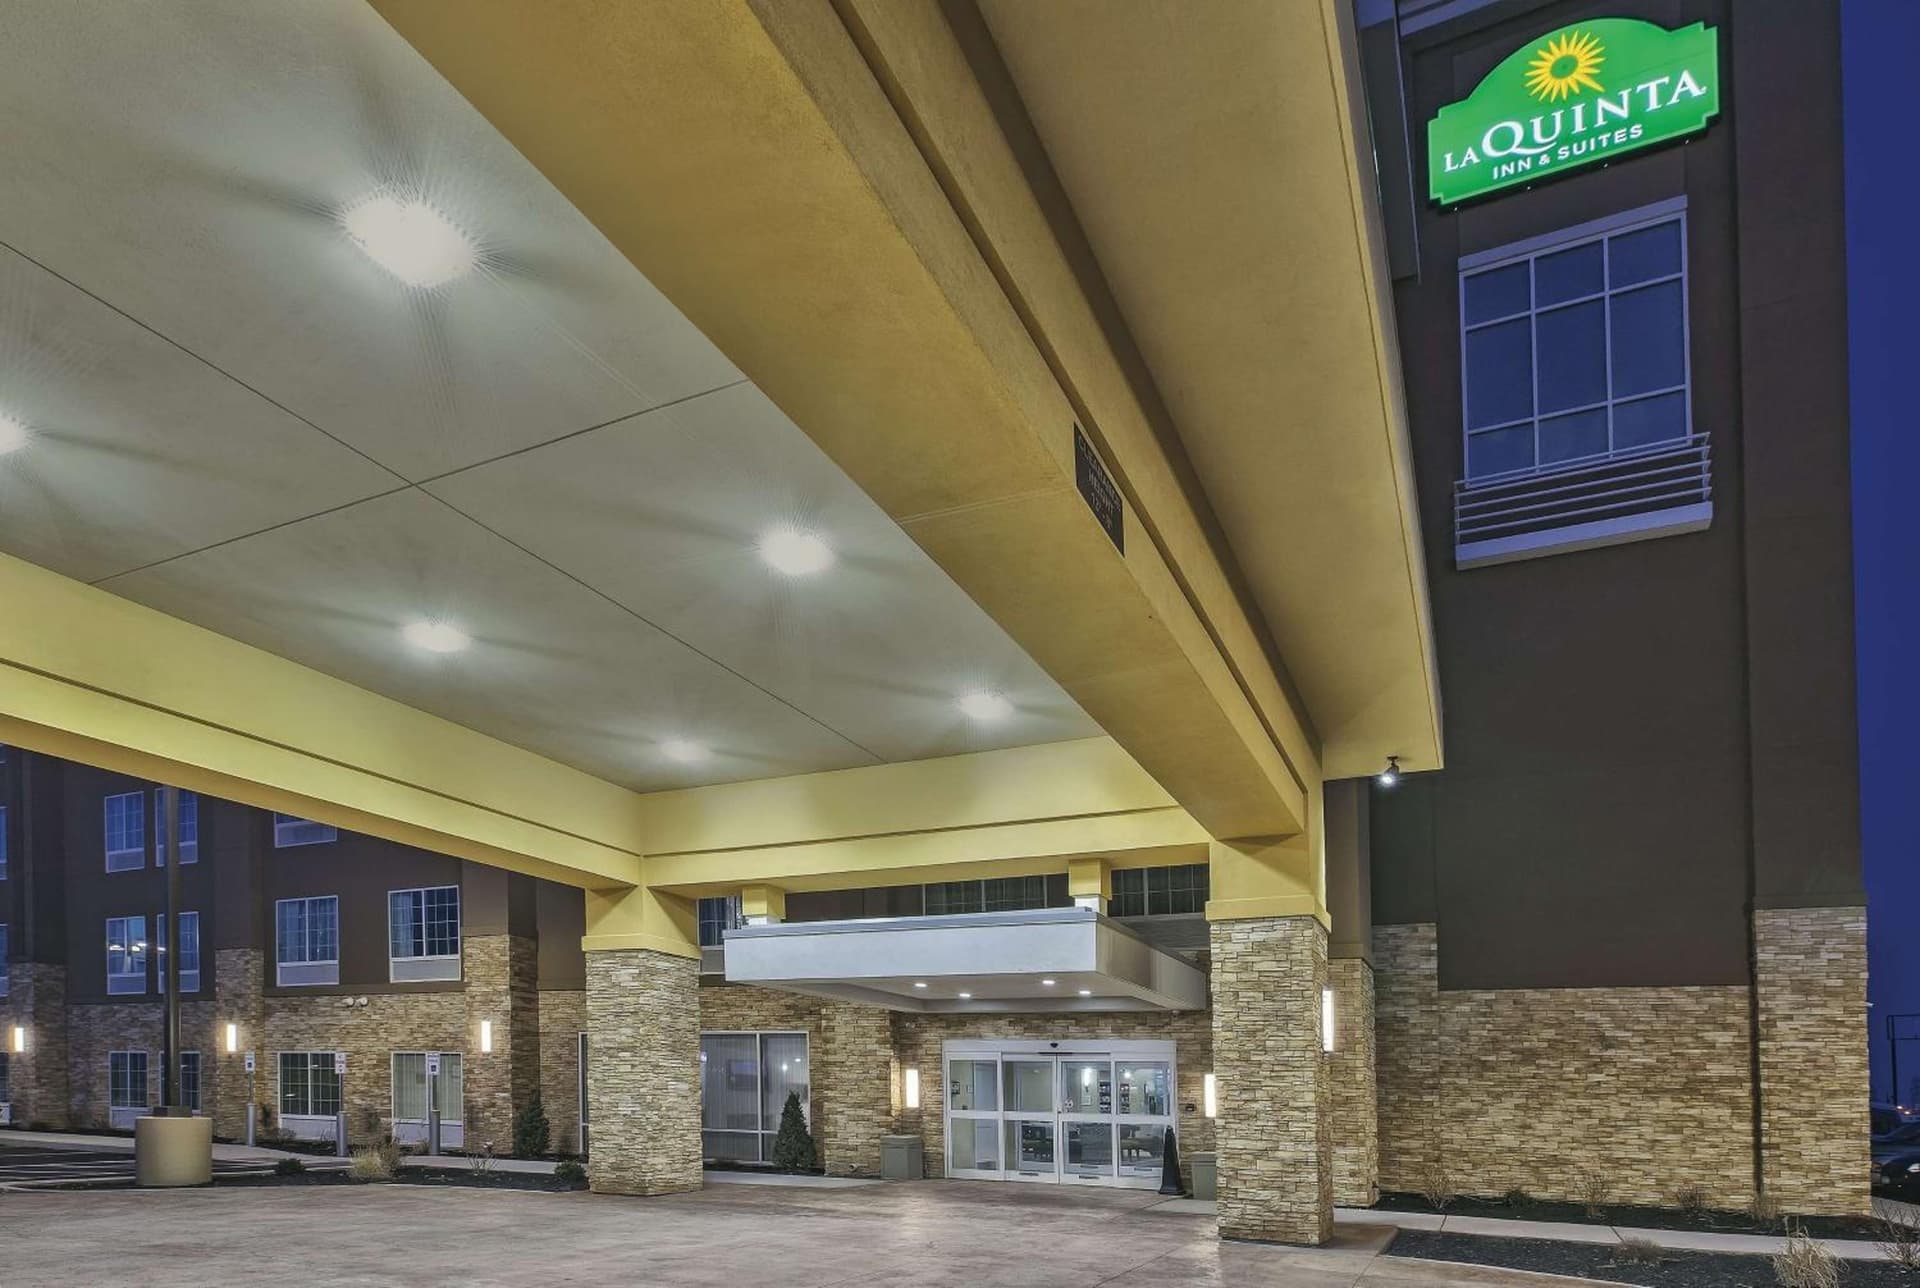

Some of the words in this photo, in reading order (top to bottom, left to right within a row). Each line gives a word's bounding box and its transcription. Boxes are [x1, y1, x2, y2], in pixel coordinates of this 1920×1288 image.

[1444, 147, 1480, 172] LA
[1481, 70, 1707, 157] QUINTA
[1493, 157, 1532, 180] INN
[1539, 153, 1551, 166] &
[1557, 124, 1643, 160] SUITES
